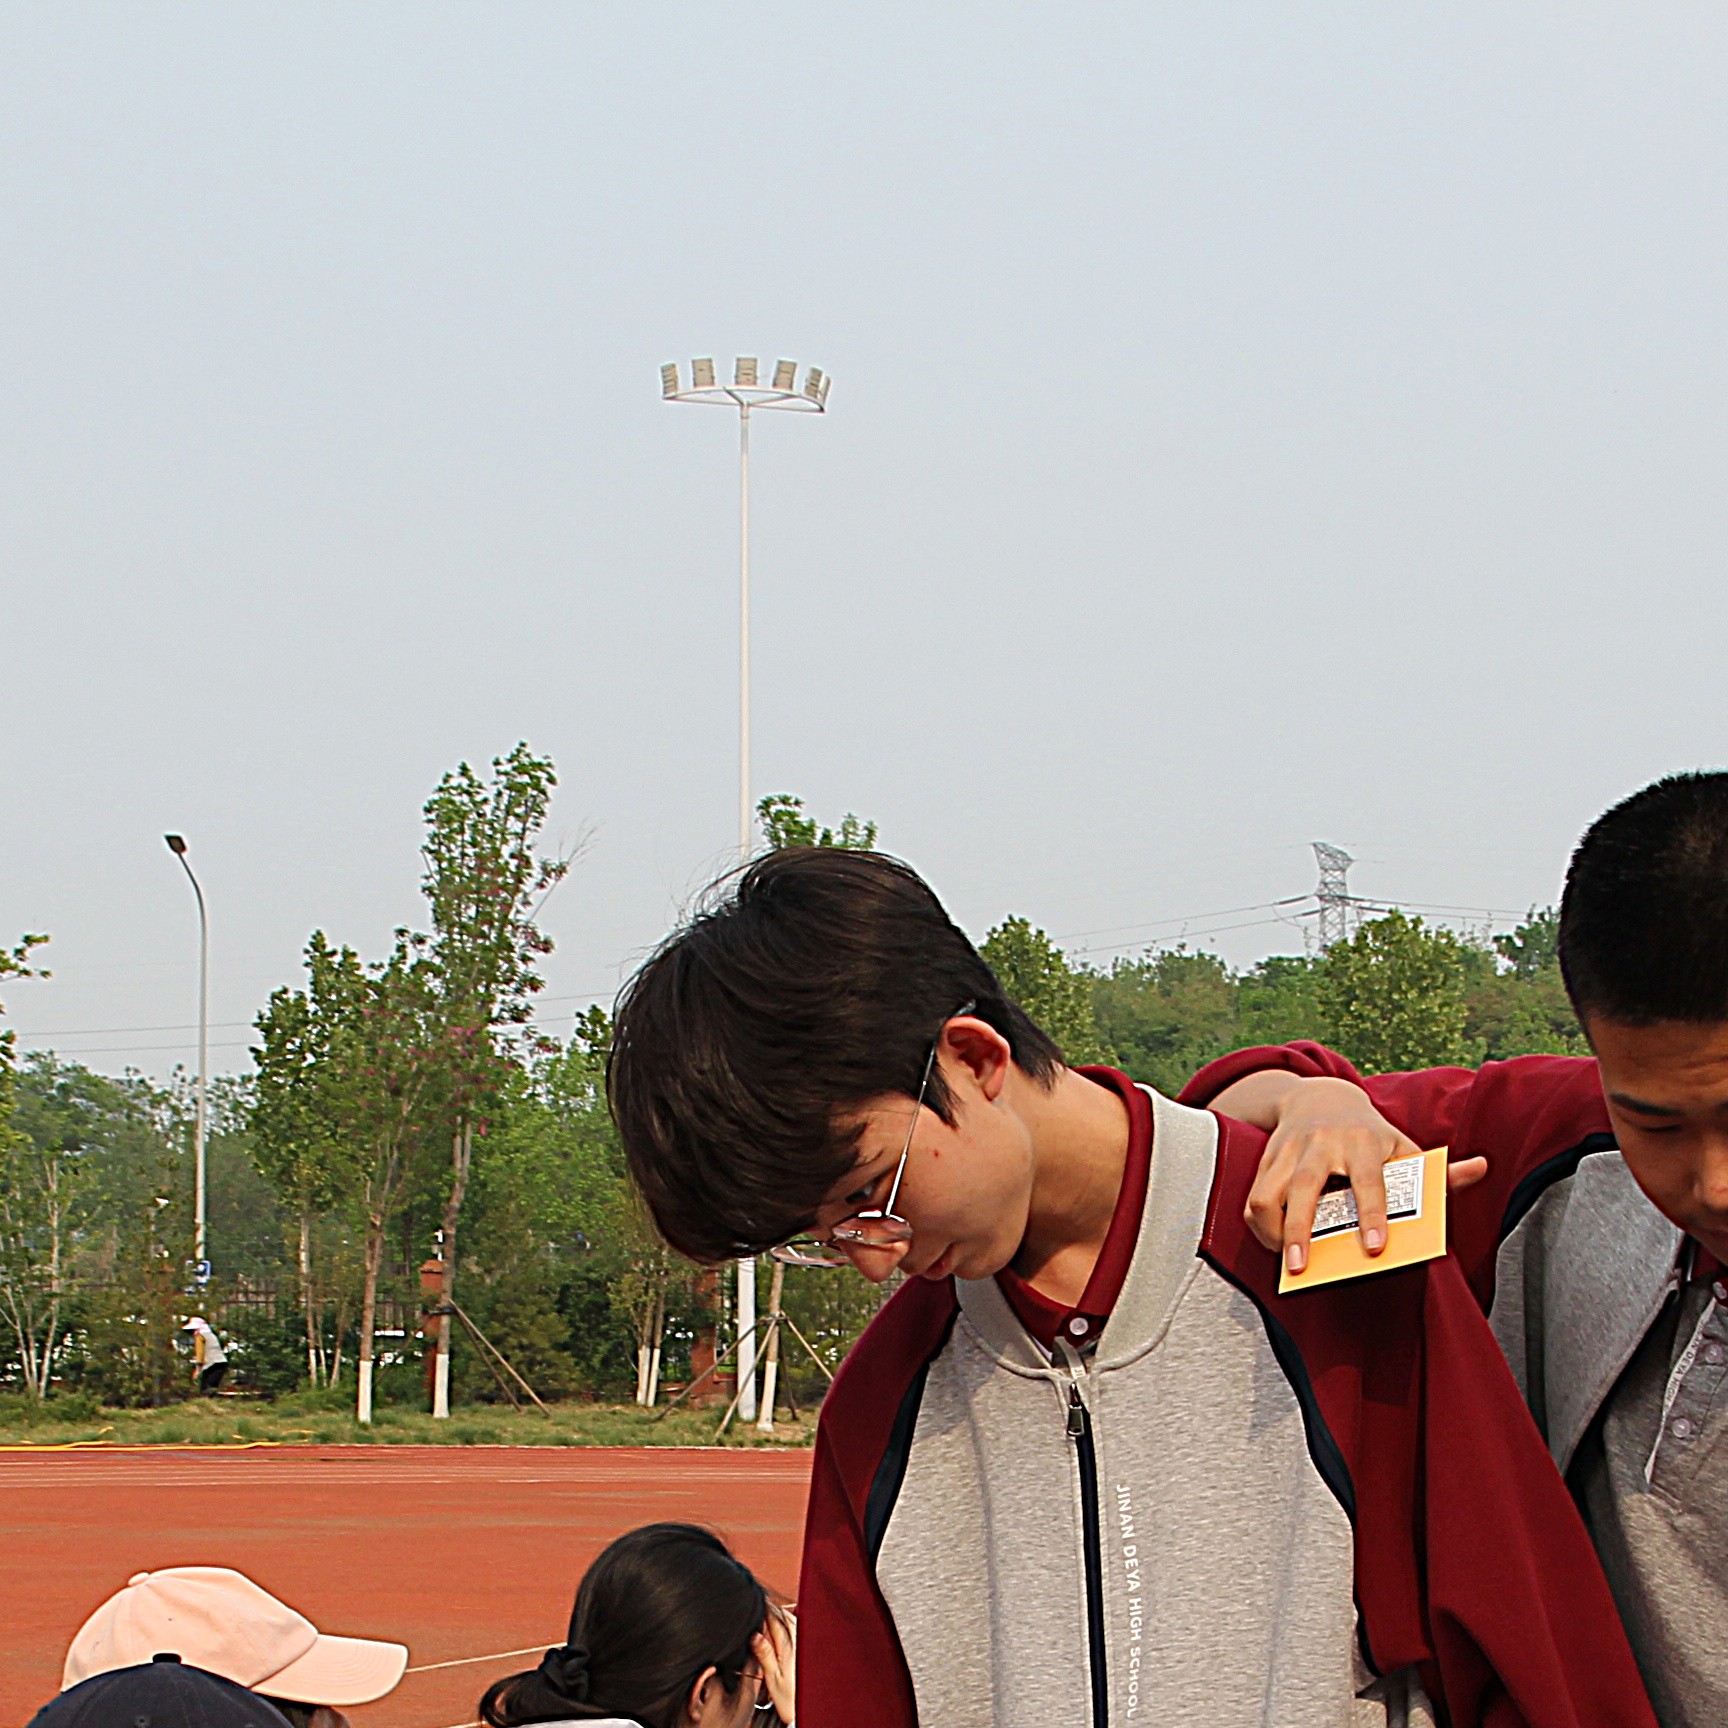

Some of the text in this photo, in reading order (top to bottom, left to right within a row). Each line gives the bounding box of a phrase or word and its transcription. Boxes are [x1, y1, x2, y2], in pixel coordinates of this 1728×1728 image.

[1676, 1352, 1696, 1375] DEYA
[1117, 1484, 1141, 1718] JINAN DEYA HIGH SCHOOL
